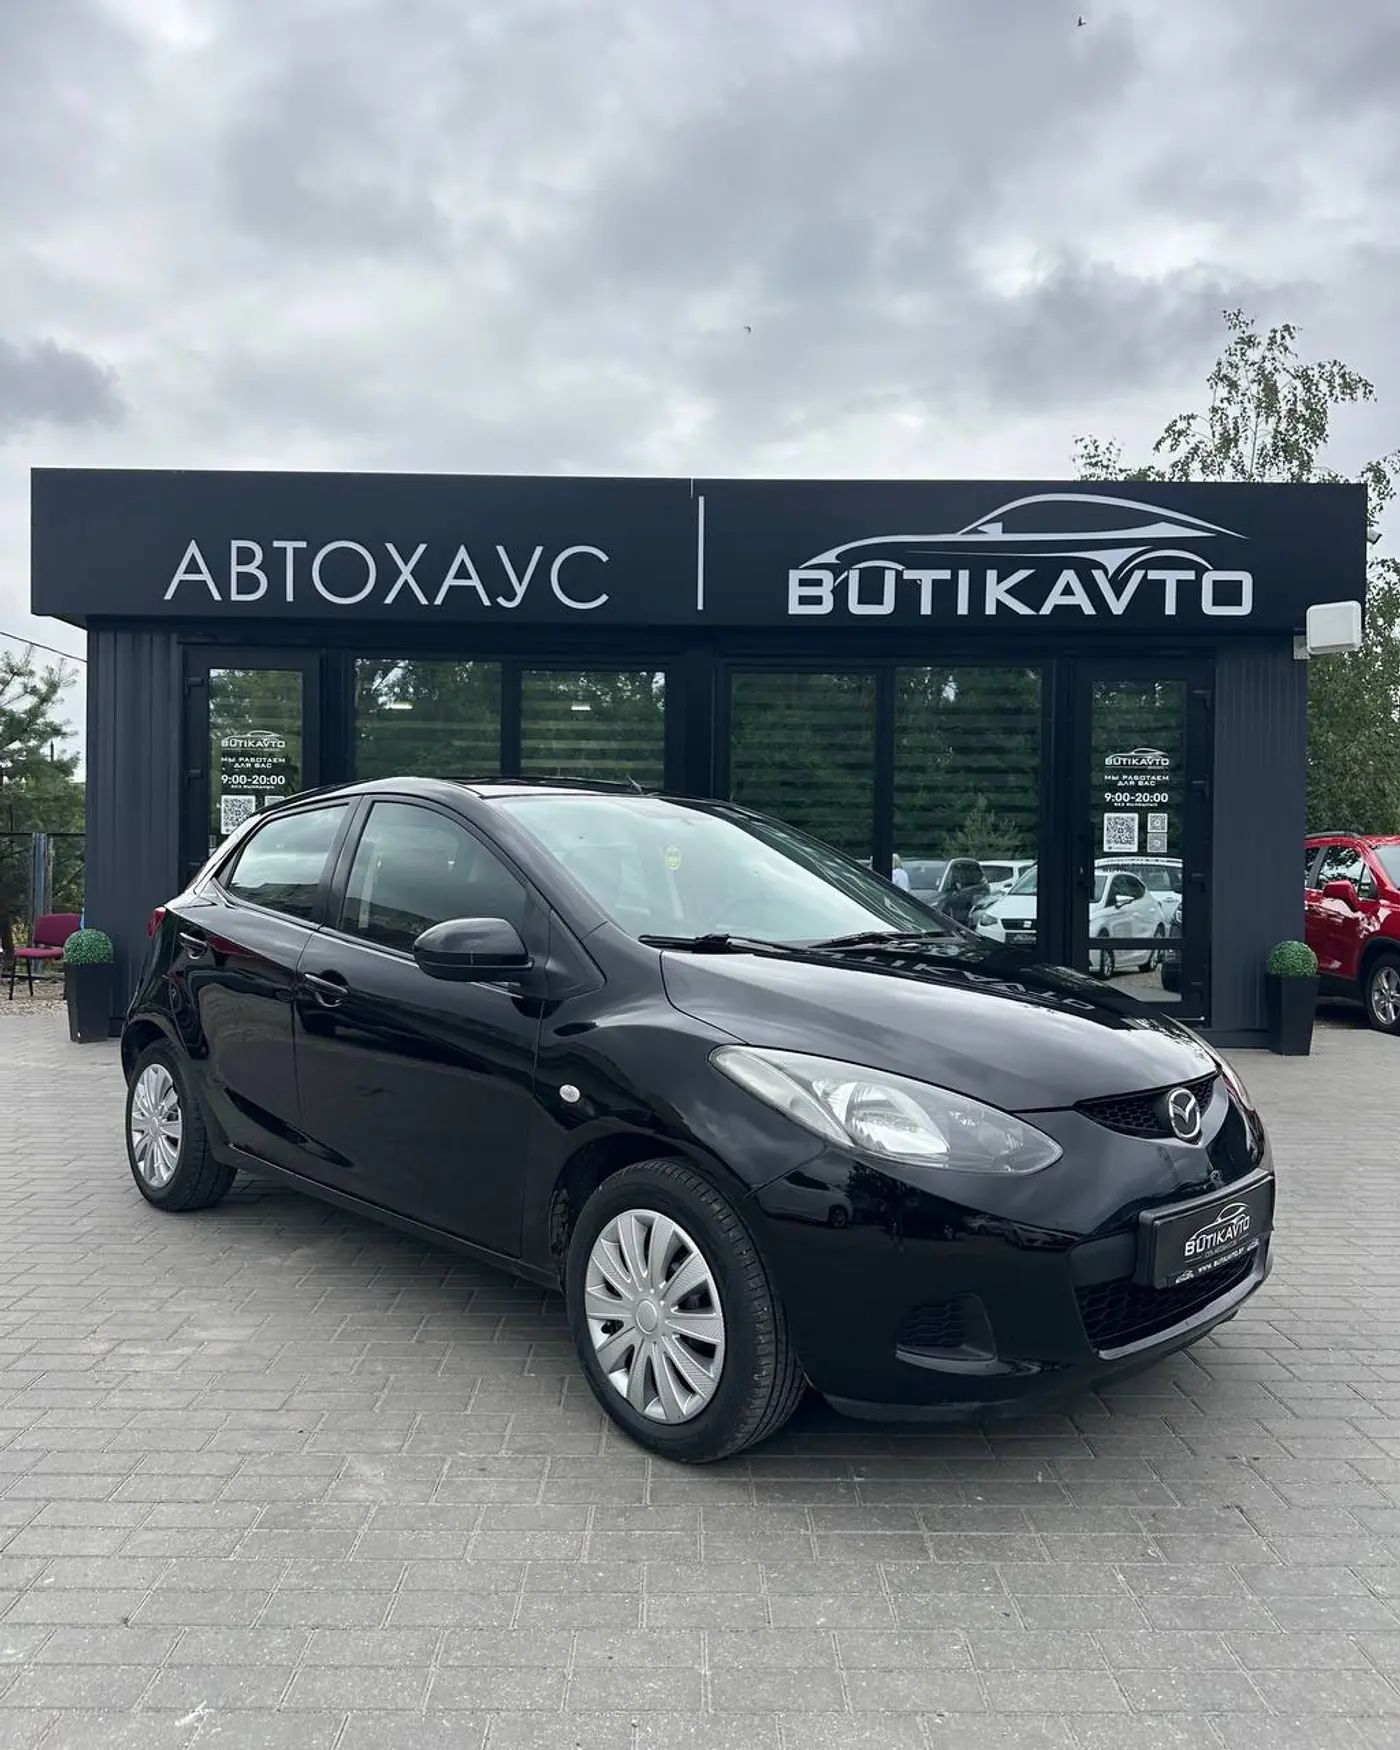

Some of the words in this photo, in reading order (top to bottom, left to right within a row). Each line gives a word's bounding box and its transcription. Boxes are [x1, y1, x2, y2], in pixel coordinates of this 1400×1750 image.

[164, 539, 609, 609] АВТОХАУС
[787, 569, 1253, 616] BUTIKAVTO
[1104, 757, 1170, 766] BUTIKAVTO
[221, 774, 286, 785] 9:00-20:00
[1104, 792, 1169, 803] 9:00-20:00
[1184, 1215, 1251, 1257] BUTIKAVTO
